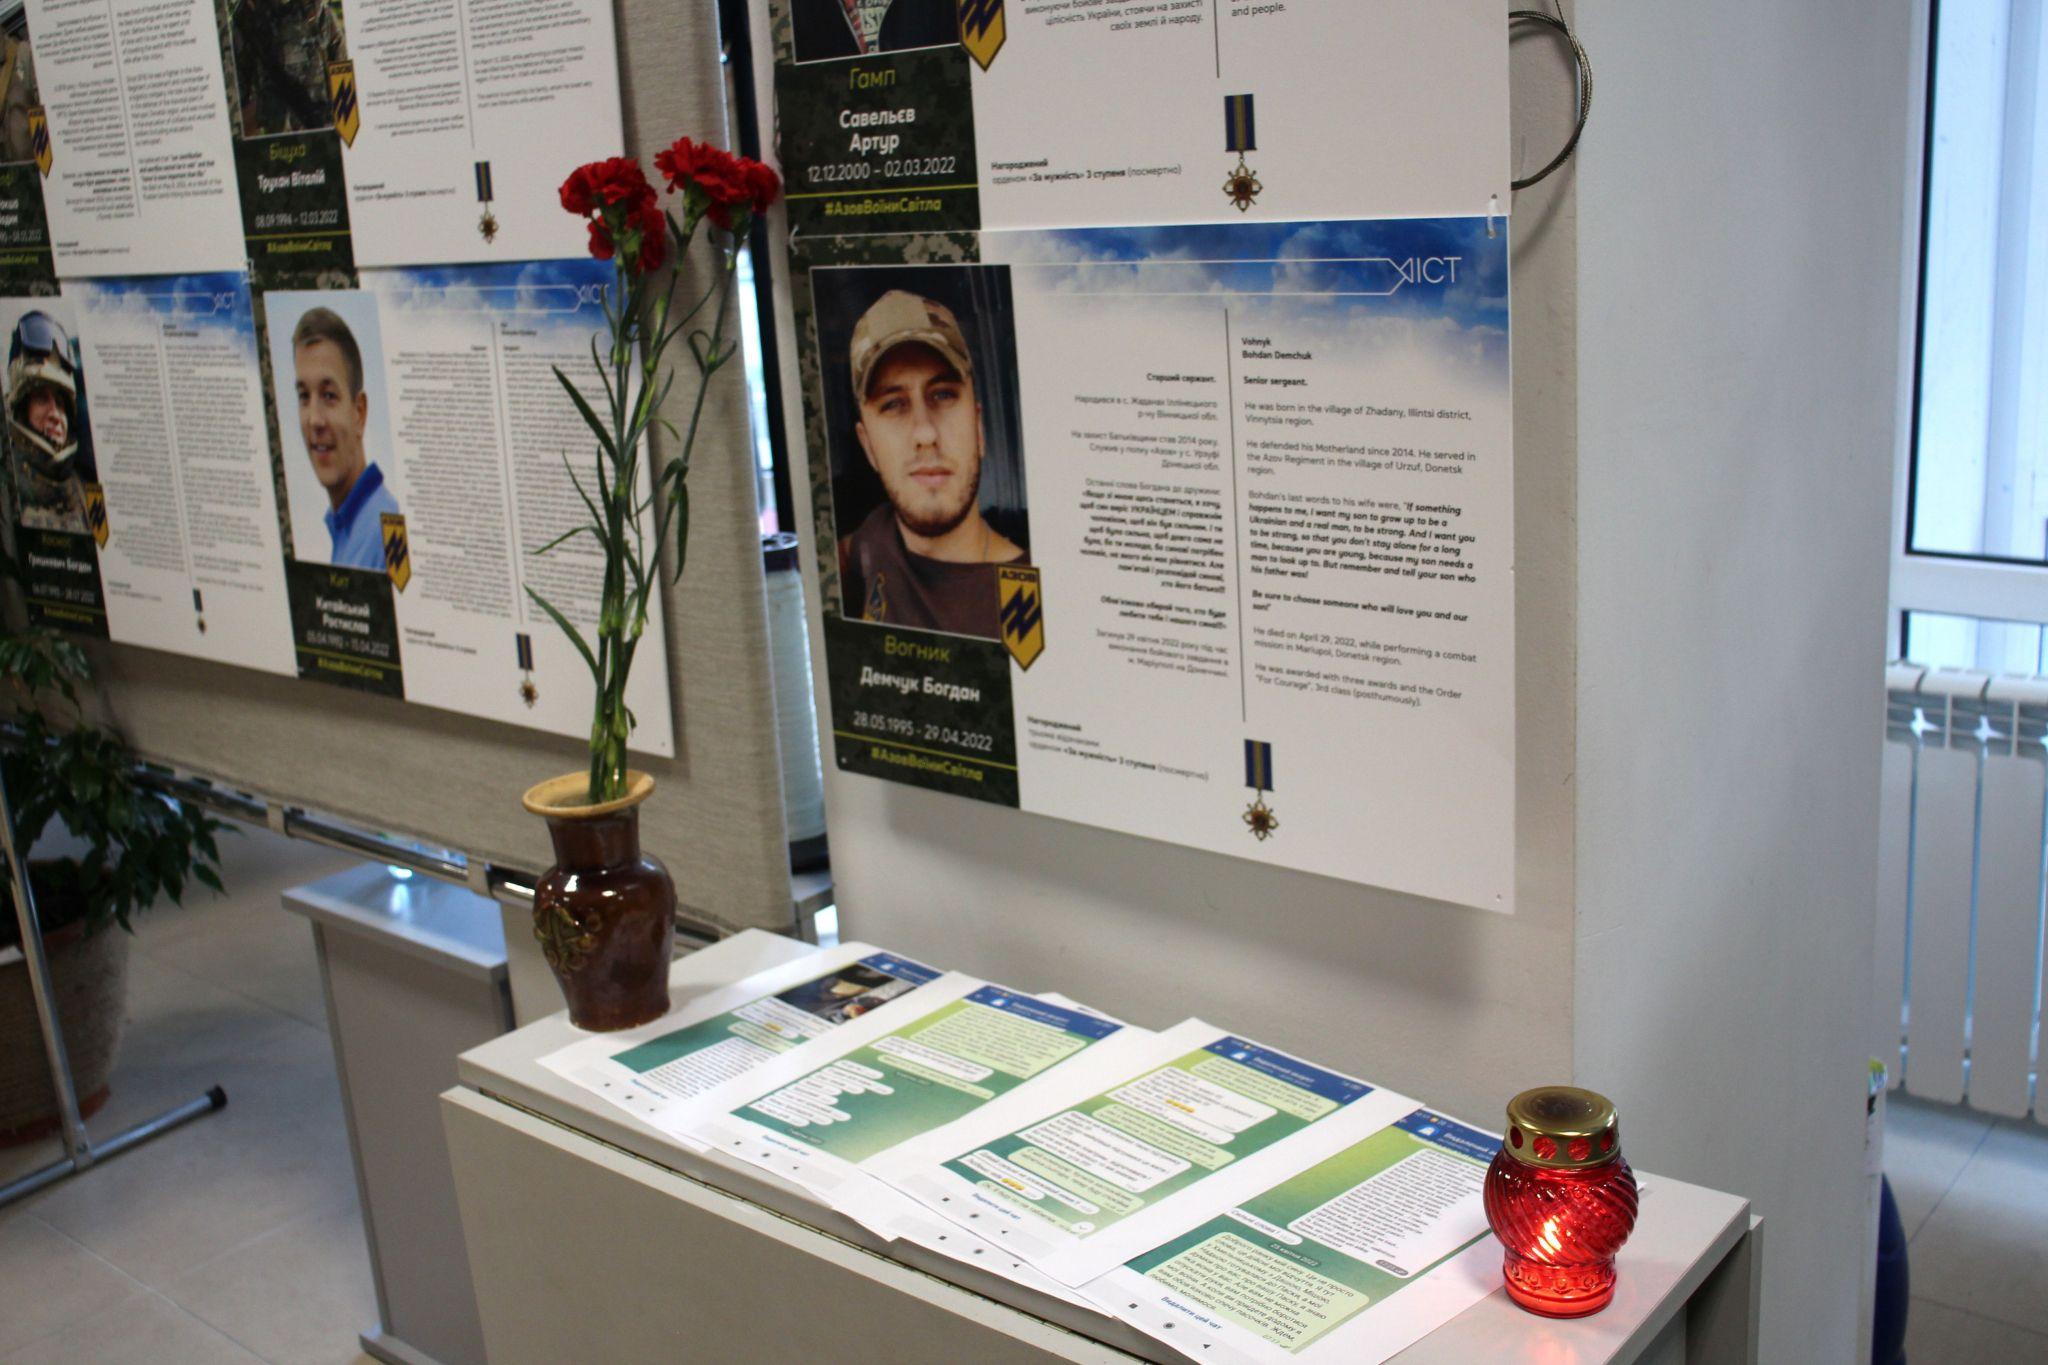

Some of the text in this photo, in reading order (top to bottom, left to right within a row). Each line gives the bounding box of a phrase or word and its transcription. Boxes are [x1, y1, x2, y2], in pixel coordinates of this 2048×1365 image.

[1232, 3, 1286, 17] and people.
[850, 68, 895, 89] Гамп
[839, 108, 916, 128] Савельєв
[850, 134, 899, 155] Артур
[807, 162, 870, 182] 12.12.2000
[884, 156, 956, 178] 02.03.2022
[1241, 350, 1312, 360] Bohdan Demchuk
[1243, 375, 1268, 384] Senior
[1275, 402, 1296, 411] born
[1307, 404, 1322, 413] the
[1324, 404, 1352, 415] village
[1259, 441, 1300, 450] defended
[1300, 442, 1314, 452] his
[1314, 443, 1366, 454] Motherland
[1367, 447, 1390, 456] since
[1433, 451, 1465, 460] served
[1246, 452, 1261, 461] the
[1262, 453, 1283, 462] Azov
[1283, 454, 1325, 465] Regiment
[1336, 458, 1352, 467] the
[1353, 459, 1383, 470] village
[1424, 462, 1463, 473] Donetsk
[1248, 503, 1282, 513] happens
[1379, 515, 1402, 523] grow
[1248, 515, 1287, 525] Ukrainian
[1288, 519, 1305, 527] and
[1312, 521, 1329, 529] real
[1408, 529, 1427, 538] And
[884, 635, 950, 662] Вогник
[860, 666, 980, 702] Демчук Богдан
[853, 711, 913, 736] 28.05.1995
[924, 724, 993, 751] 29.04.2022
